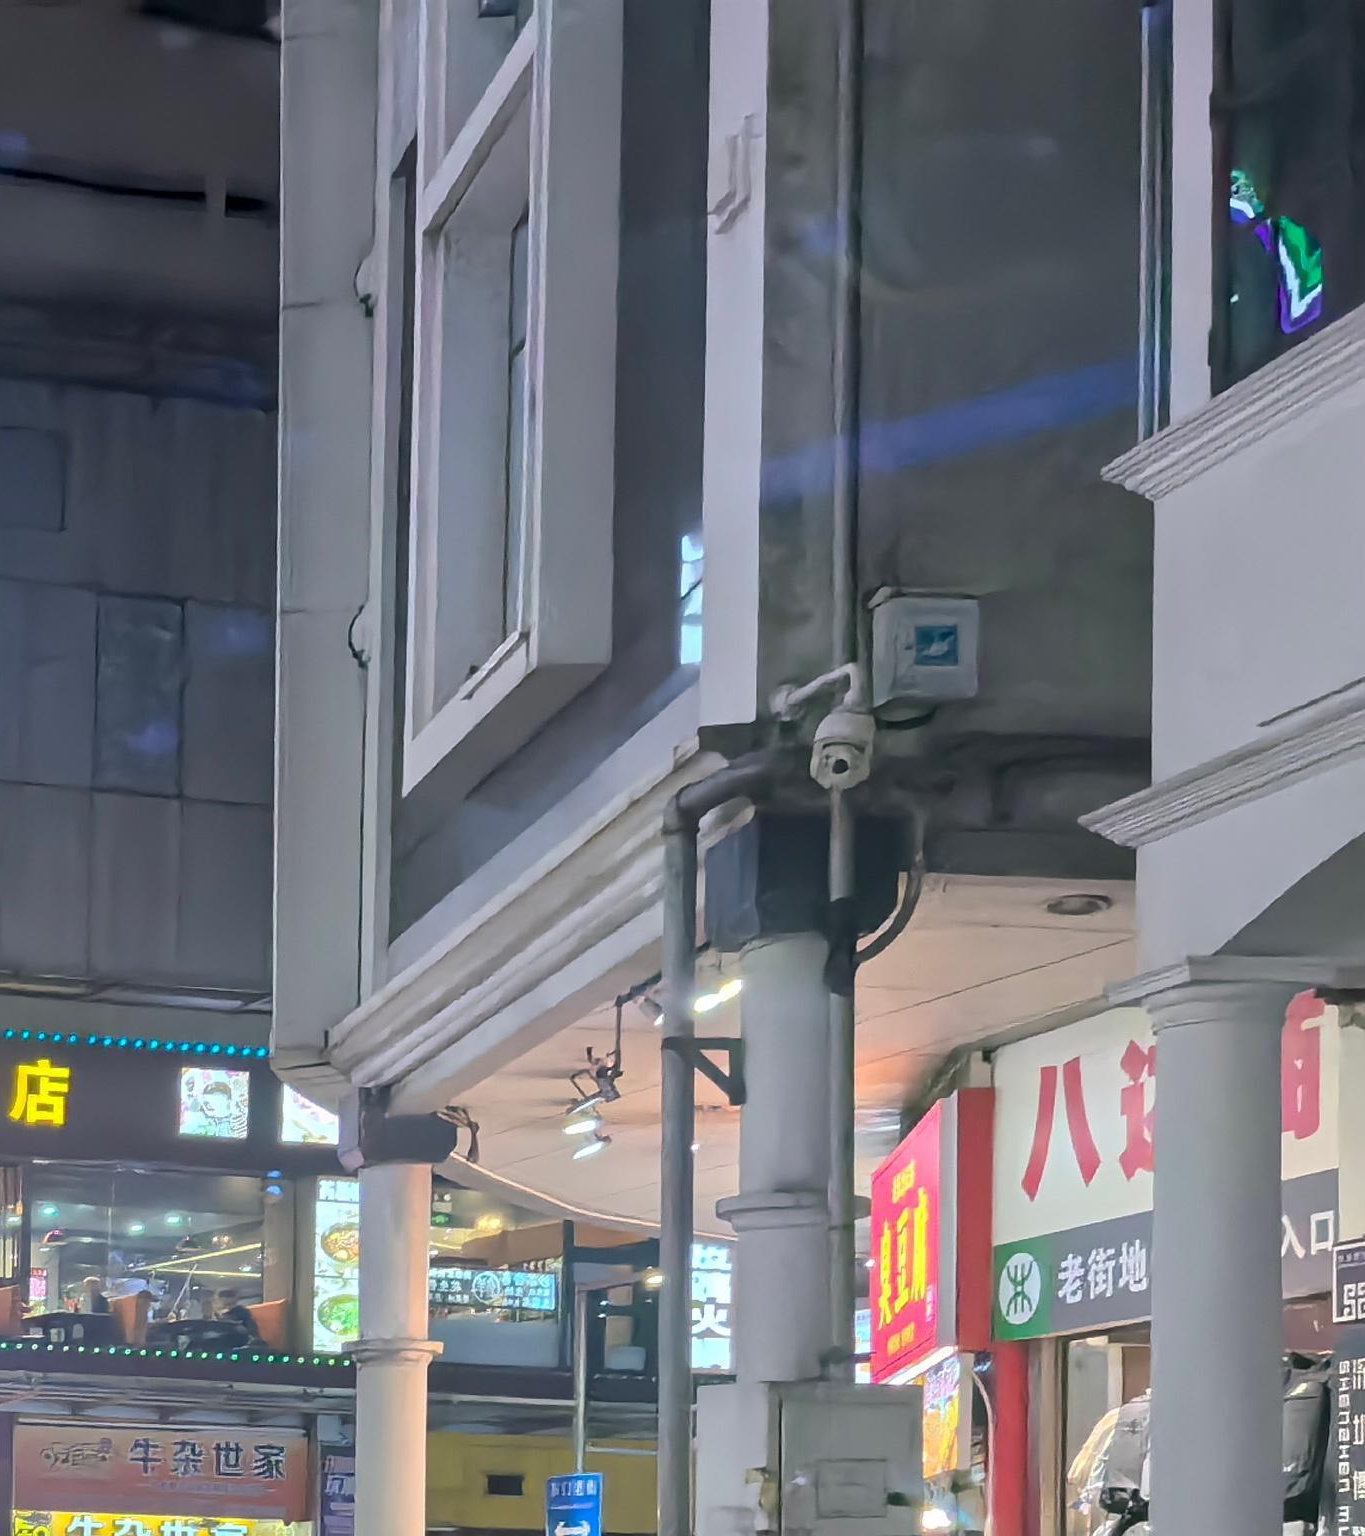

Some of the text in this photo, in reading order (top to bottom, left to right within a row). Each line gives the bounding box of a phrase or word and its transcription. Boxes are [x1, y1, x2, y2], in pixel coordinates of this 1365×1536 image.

[1057, 1239, 1152, 1304] 老街地
[127, 1437, 287, 1480] 牛杂世家
